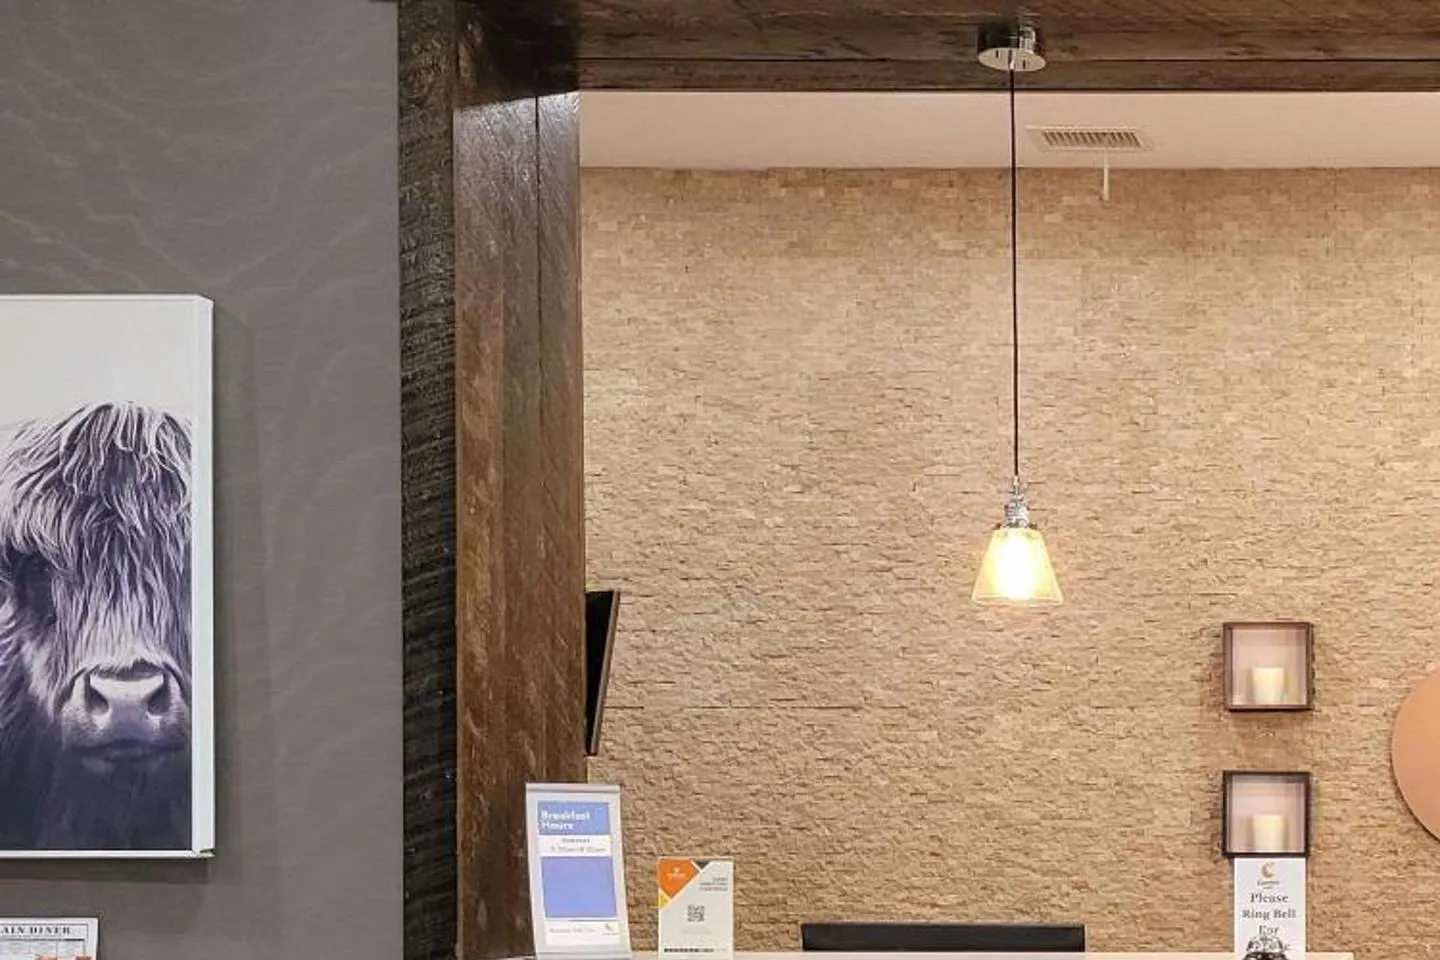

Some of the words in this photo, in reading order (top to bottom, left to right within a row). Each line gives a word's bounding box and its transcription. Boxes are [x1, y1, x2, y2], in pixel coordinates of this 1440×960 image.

[540, 810, 591, 821] Breakfast
[539, 820, 574, 830] Hours
[1250, 892, 1289, 904] Please
[1242, 908, 1270, 920] Ring
[1273, 908, 1297, 918] Bell
[1259, 925, 1280, 936] For
